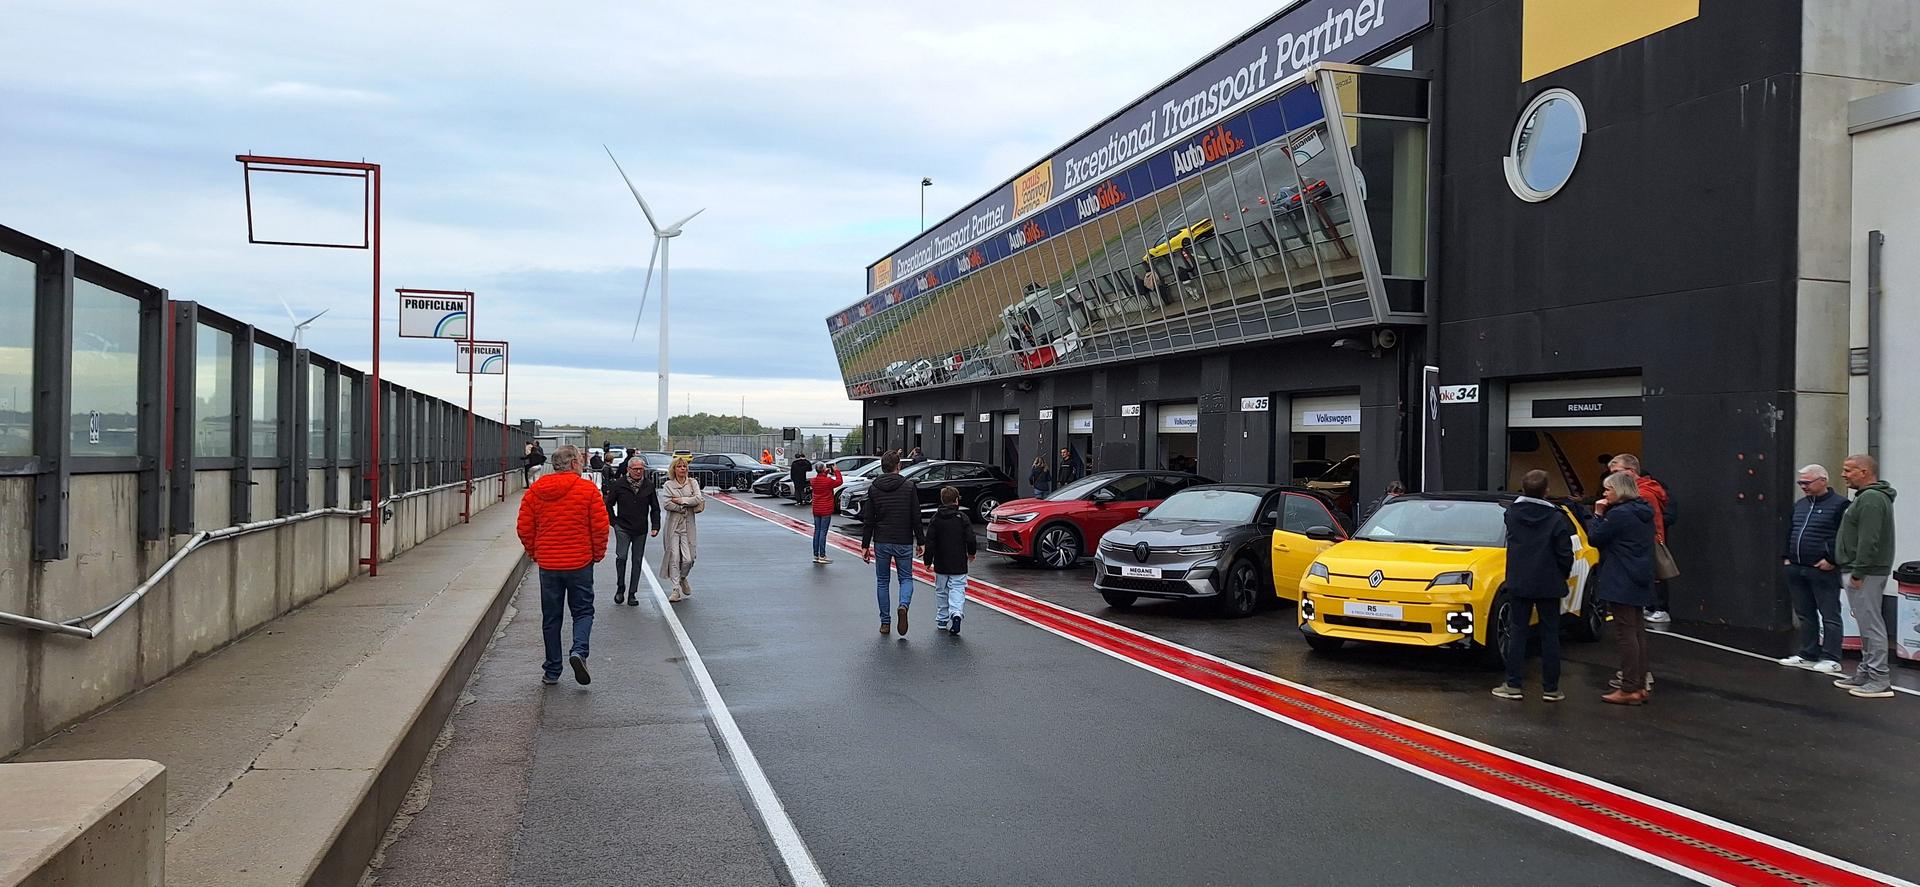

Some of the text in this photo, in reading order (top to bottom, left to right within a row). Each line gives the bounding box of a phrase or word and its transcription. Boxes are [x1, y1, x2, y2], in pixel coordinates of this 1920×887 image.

[1064, 110, 1156, 190] Exceptional
[1162, 46, 1269, 138] Transport
[934, 219, 970, 260] Transport
[971, 204, 1005, 240] Partner
[405, 299, 464, 312] PROFICLEAN
[460, 346, 501, 355] PRFICLEAN
[1440, 387, 1478, 401] oke 34
[1255, 399, 1268, 409] 35
[1568, 403, 1603, 412] RENAULT
[1316, 413, 1352, 425] Volkswagen
